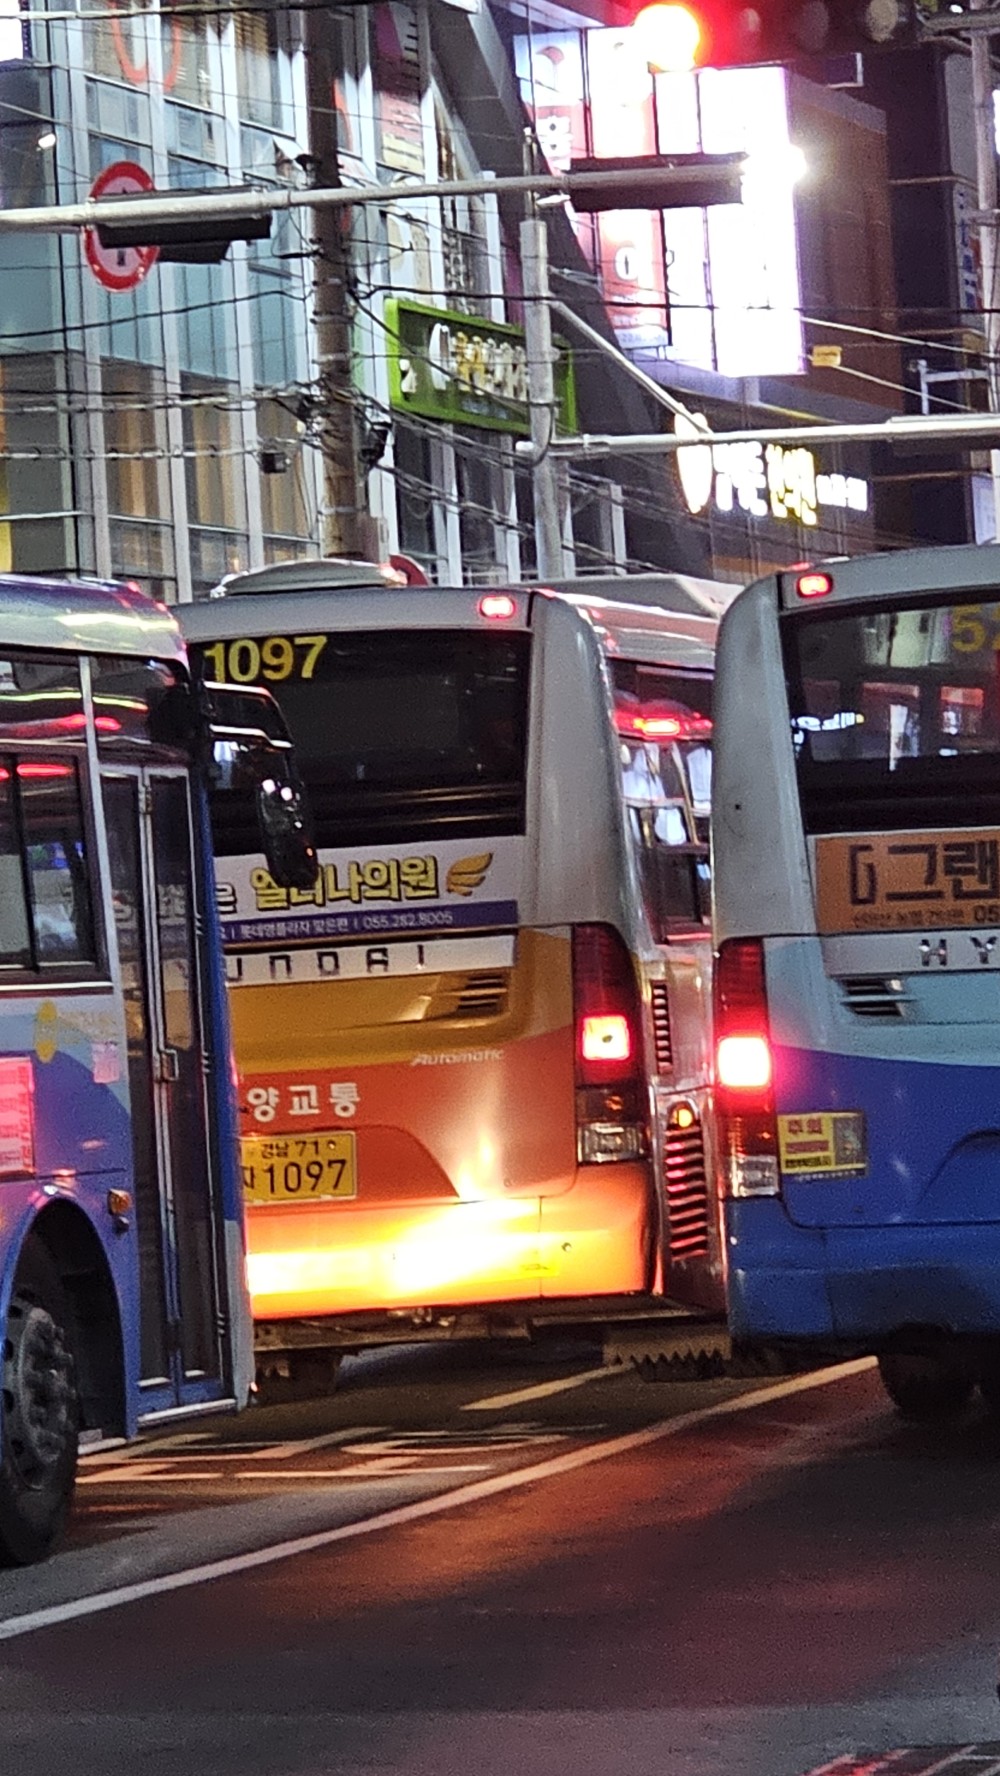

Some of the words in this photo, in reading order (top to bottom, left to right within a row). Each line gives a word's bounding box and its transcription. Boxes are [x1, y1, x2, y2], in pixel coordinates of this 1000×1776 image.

[203, 635, 328, 683] 1097
[919, 936, 999, 967] HY
[410, 1049, 505, 1066] Automatic
[261, 1143, 289, 1159] 경남
[295, 1140, 319, 1157] 71
[262, 1158, 347, 1195] 1097
